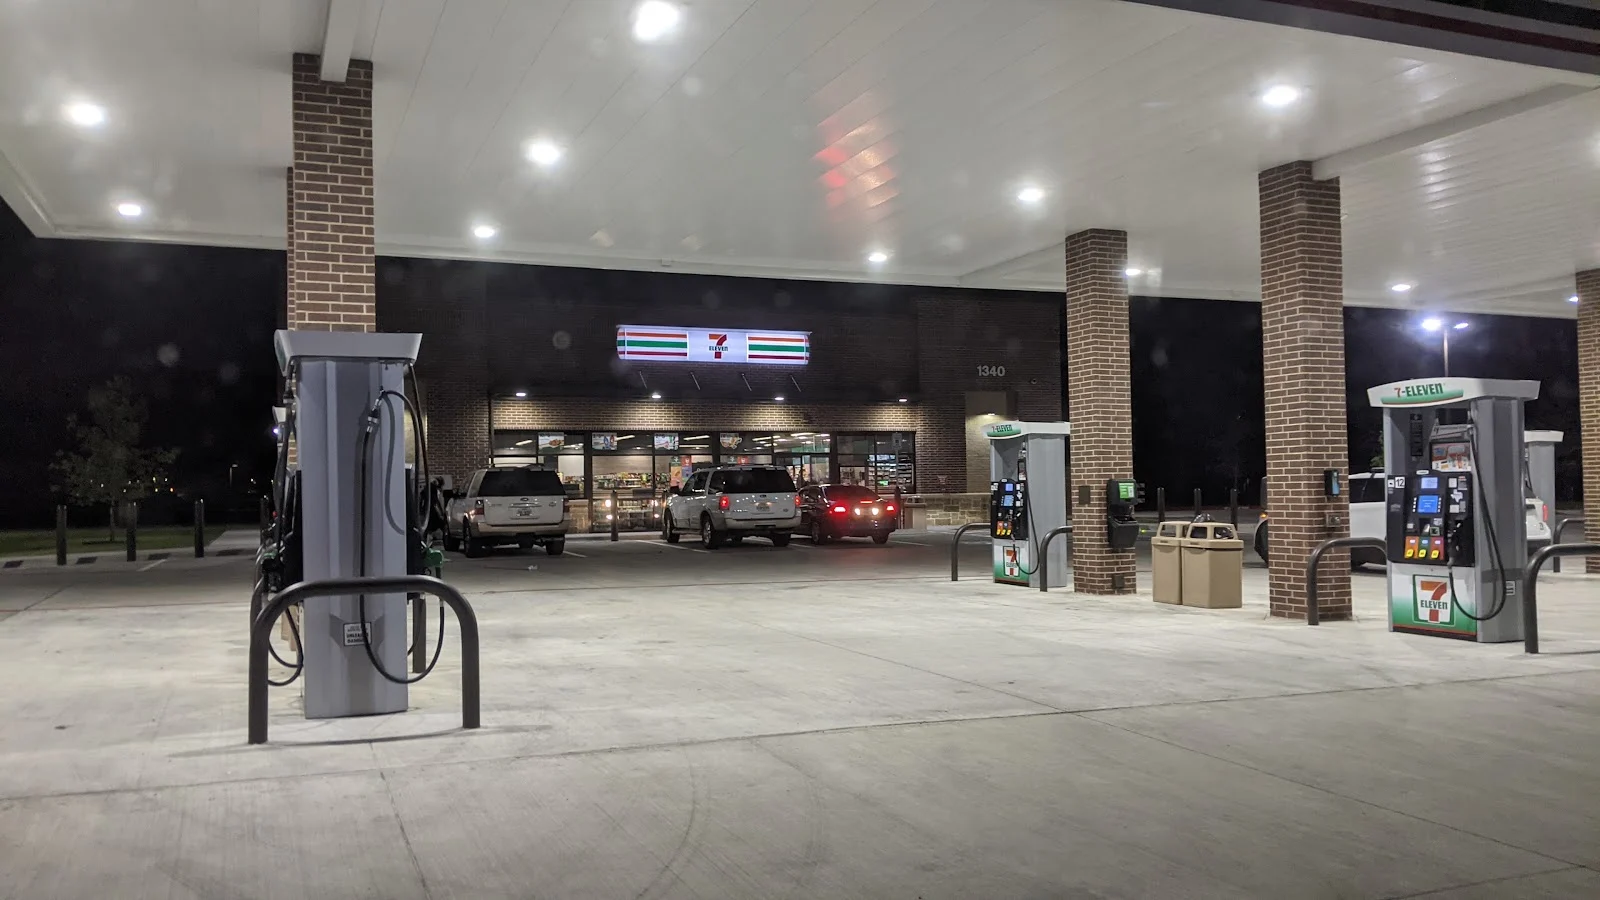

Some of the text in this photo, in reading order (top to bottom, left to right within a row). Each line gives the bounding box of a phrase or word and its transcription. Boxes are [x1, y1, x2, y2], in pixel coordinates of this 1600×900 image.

[709, 333, 727, 359] 7
[977, 365, 1006, 377] 1340
[1396, 478, 1405, 488] 12
[1420, 580, 1447, 622] 7
